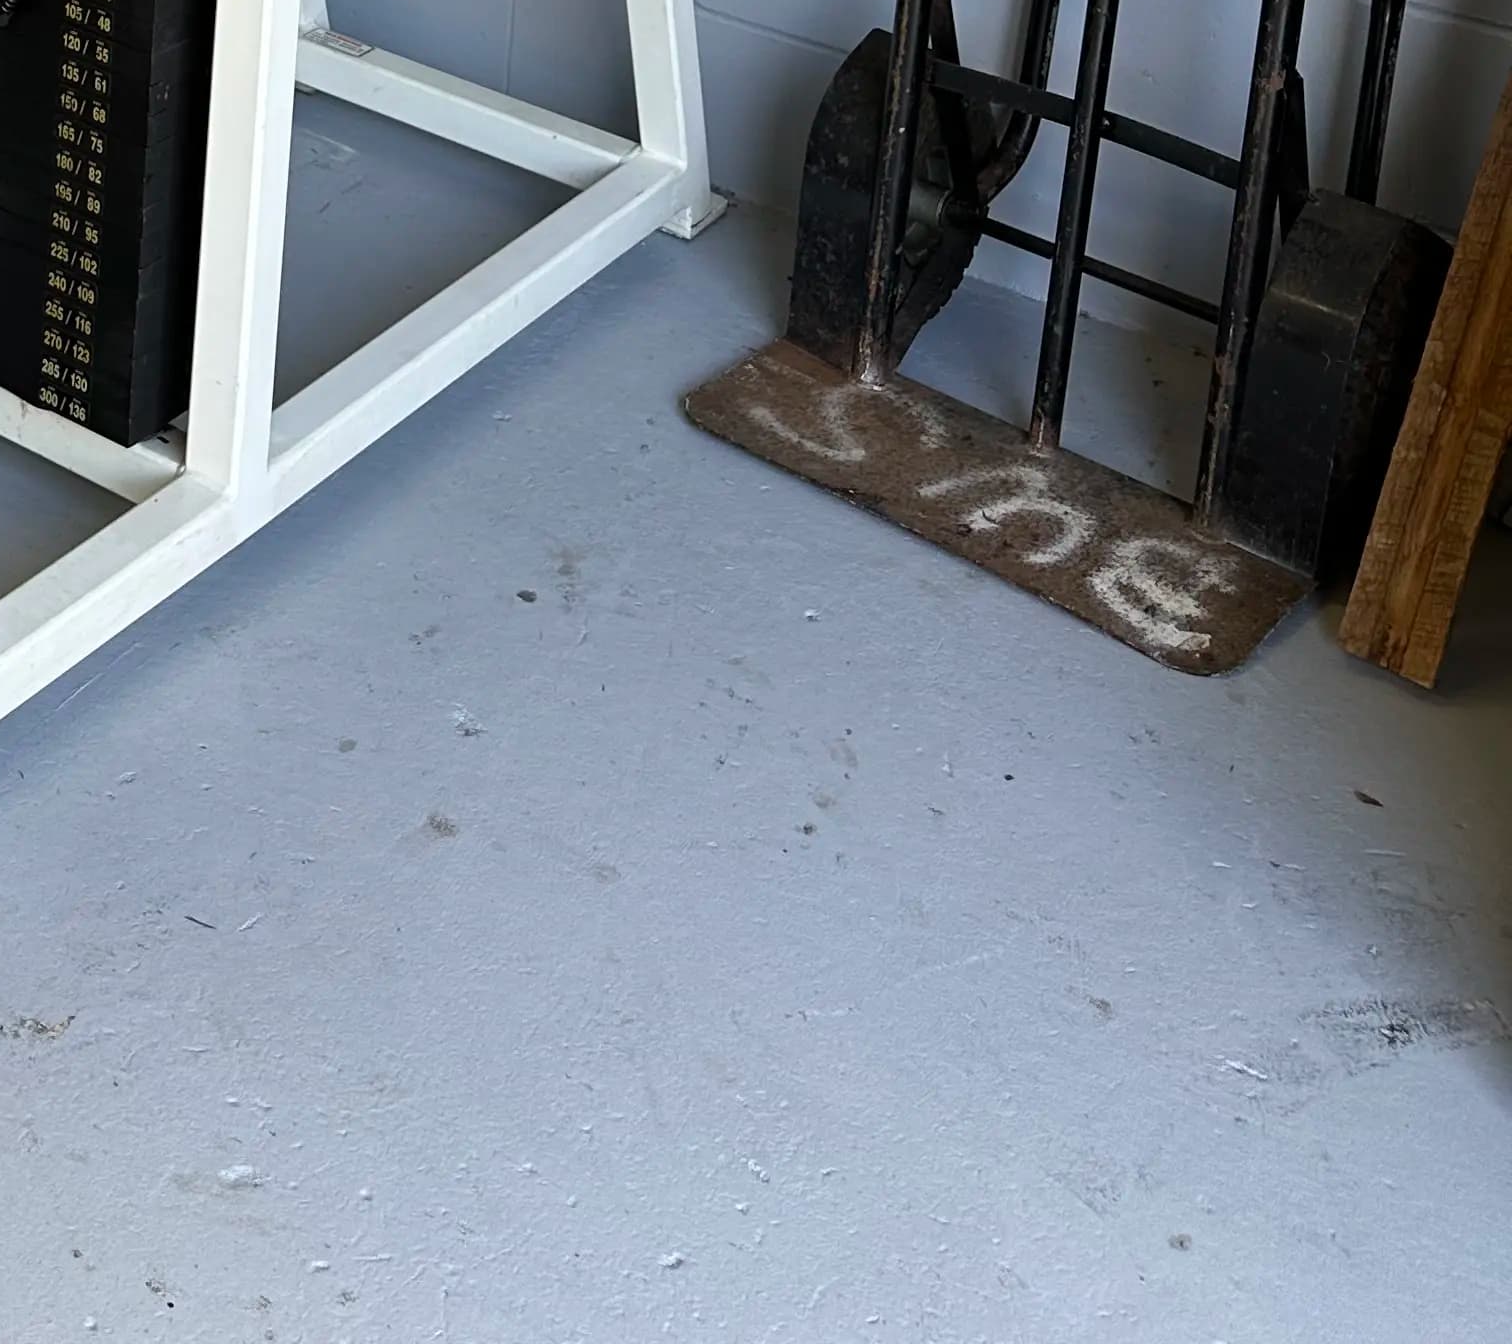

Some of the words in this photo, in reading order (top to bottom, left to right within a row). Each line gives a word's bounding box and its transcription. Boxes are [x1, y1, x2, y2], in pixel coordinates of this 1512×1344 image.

[65, 3, 82, 21] 105
[98, 16, 110, 32] 48
[63, 33, 81, 52] 120
[96, 46, 108, 62] 55
[62, 64, 79, 82] 135
[95, 77, 106, 92] 61
[61, 93, 78, 112] 150
[93, 107, 105, 123] 68
[58, 122, 75, 142] 165
[91, 137, 102, 153] 75
[56, 153, 73, 172] 180
[89, 167, 101, 184] 82
[55, 182, 72, 201] 195
[88, 197, 100, 213] 89
[52, 212, 70, 232] 210
[86, 227, 98, 243] 95
[50, 242, 69, 262] 225
[80, 256, 97, 275] 102
[48, 272, 66, 291] 240
[78, 286, 94, 304] 109
[46, 301, 63, 320] 255
[76, 317, 91, 334] 116
[44, 331, 62, 350] 270
[73, 344, 89, 363] 123
[41, 358, 60, 378] 285
[71, 374, 87, 392] 130
[40, 388, 58, 407] 300
[69, 402, 85, 421] 136
